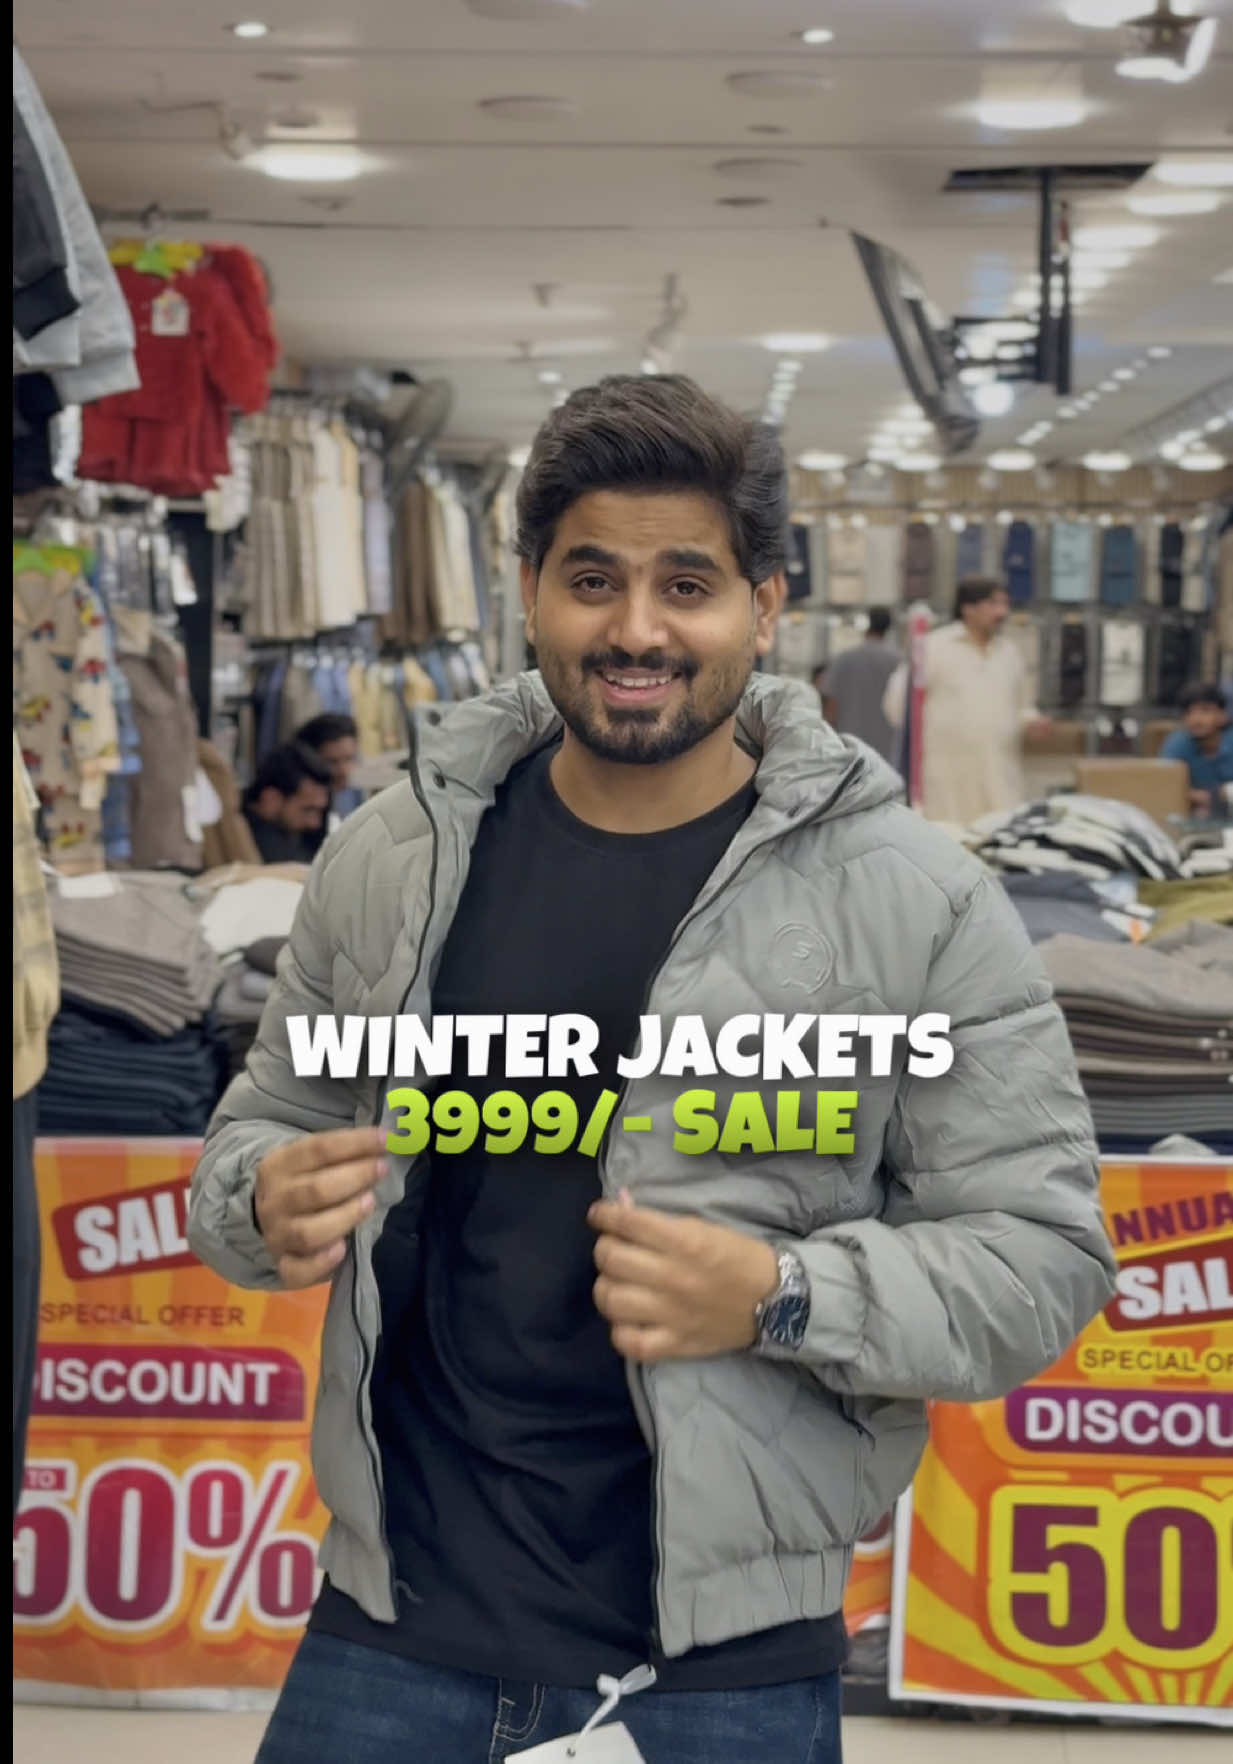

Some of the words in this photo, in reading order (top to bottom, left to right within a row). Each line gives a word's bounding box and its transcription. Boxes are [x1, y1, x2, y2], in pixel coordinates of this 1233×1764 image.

[73, 1187, 191, 1273] SAL
[41, 1302, 150, 1326] SPECIAL
[158, 1304, 246, 1327] OFFER
[34, 1358, 280, 1405] ISCOUNT
[1083, 1346, 1196, 1373] SPECIAL
[1010, 1503, 1233, 1650] 50
